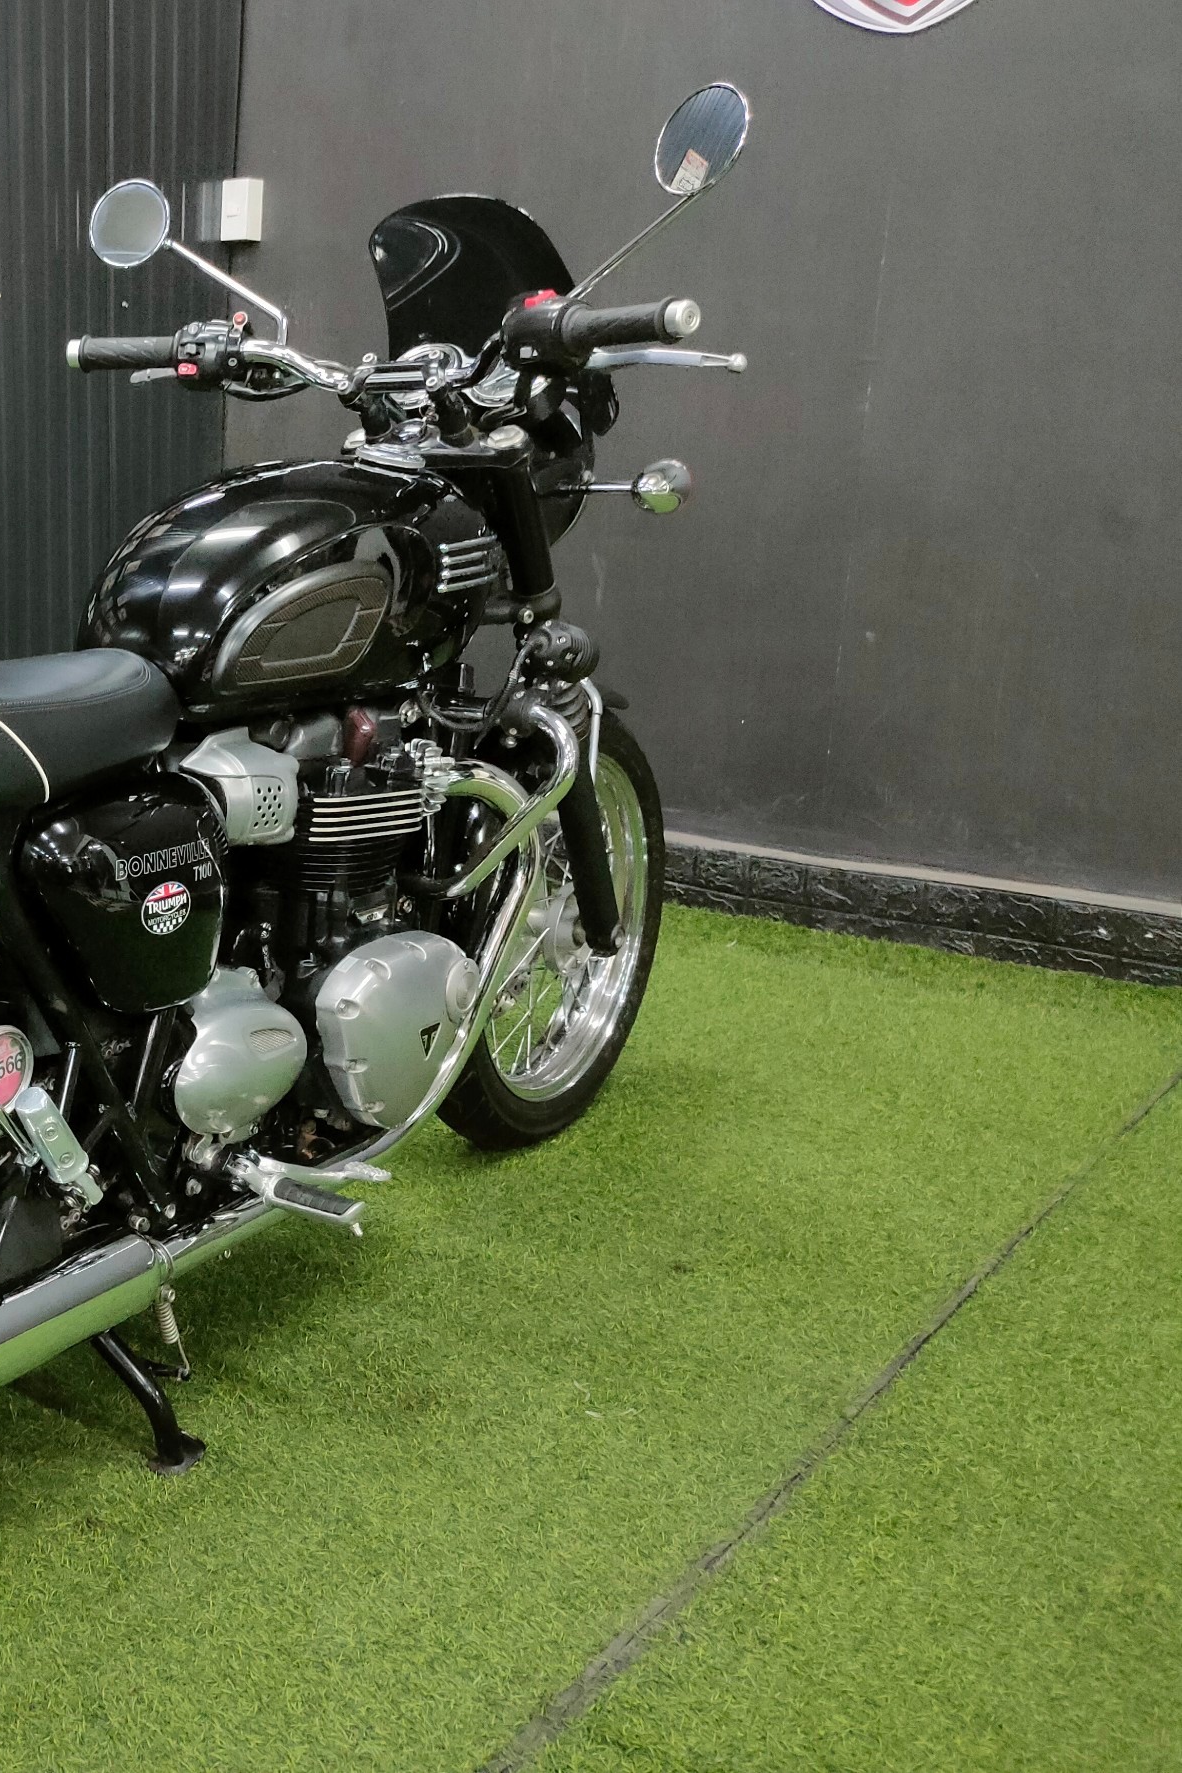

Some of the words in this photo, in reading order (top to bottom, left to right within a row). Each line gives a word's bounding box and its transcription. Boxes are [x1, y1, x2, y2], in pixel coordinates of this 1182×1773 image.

[116, 837, 211, 881] BONNEVILLE
[193, 862, 213, 882] T100
[146, 892, 187, 915] TRIUMPH
[147, 908, 186, 926] MOTORCYCLES
